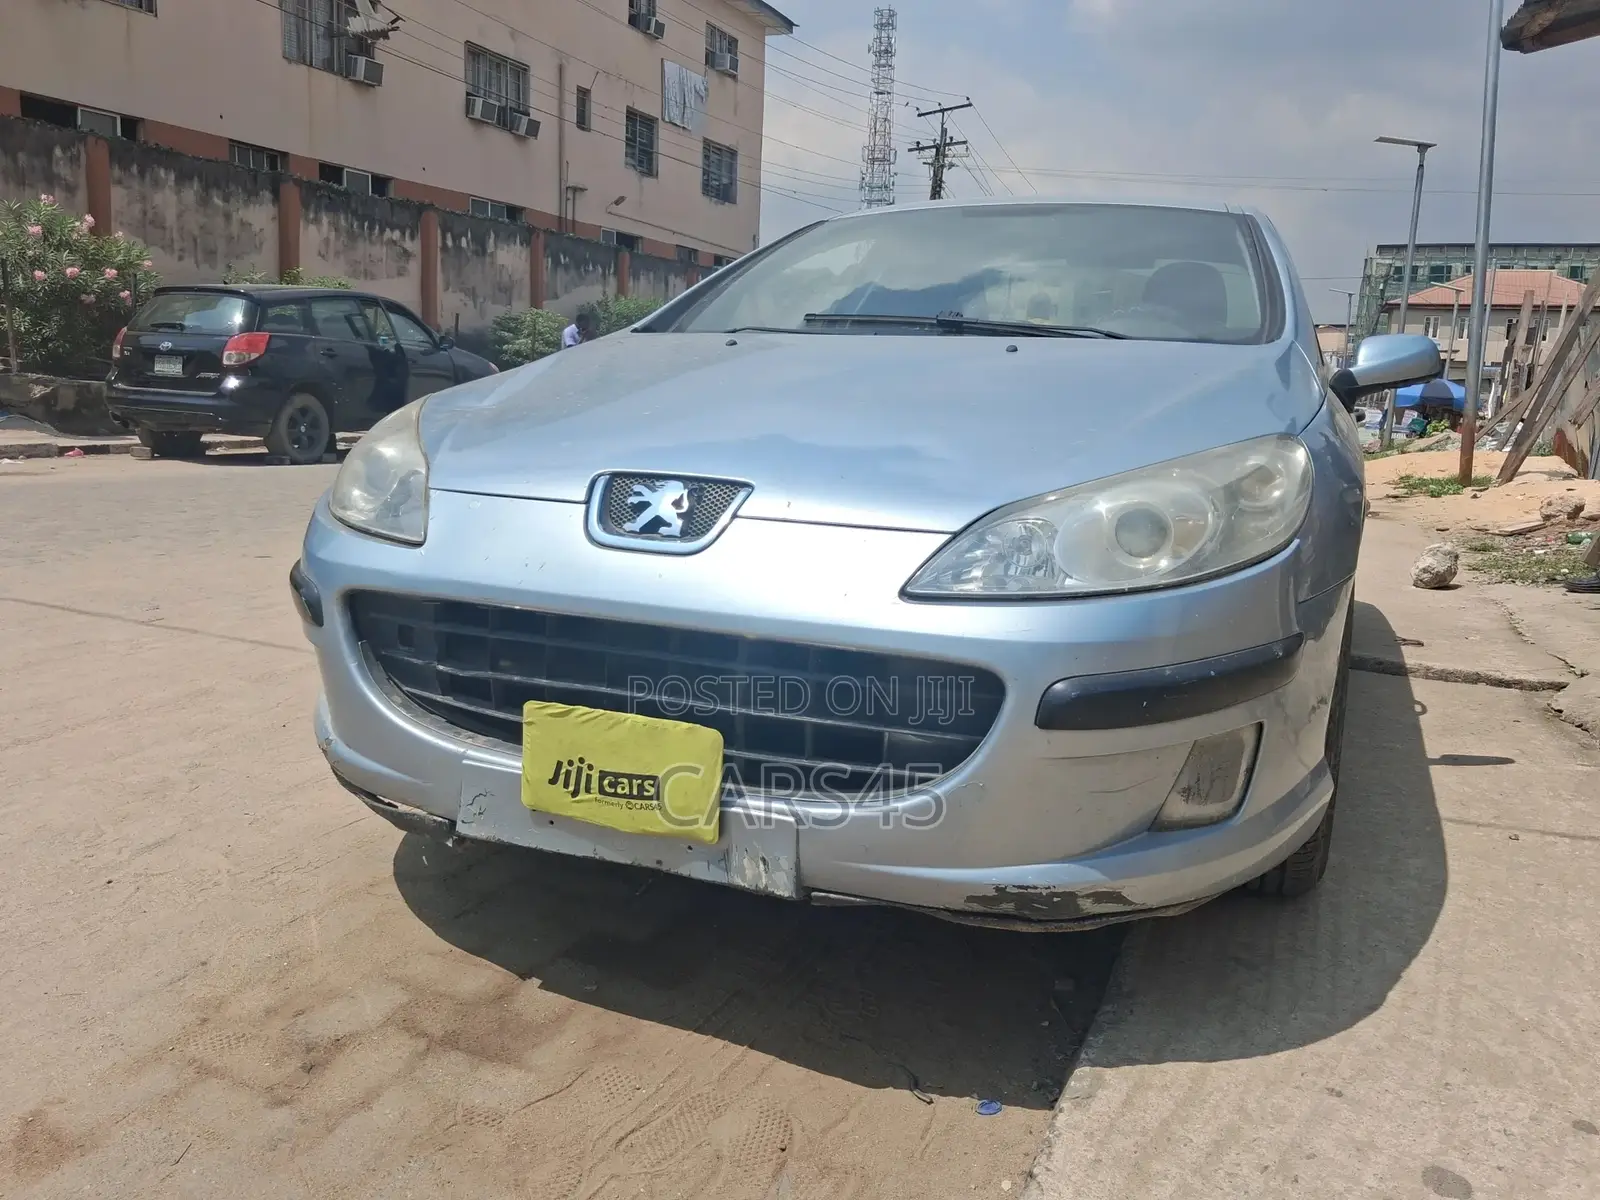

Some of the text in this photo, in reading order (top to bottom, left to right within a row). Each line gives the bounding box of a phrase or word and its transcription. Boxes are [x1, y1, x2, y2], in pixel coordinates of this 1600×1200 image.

[548, 756, 655, 799] Jiji cars
[594, 797, 624, 810] formerly
